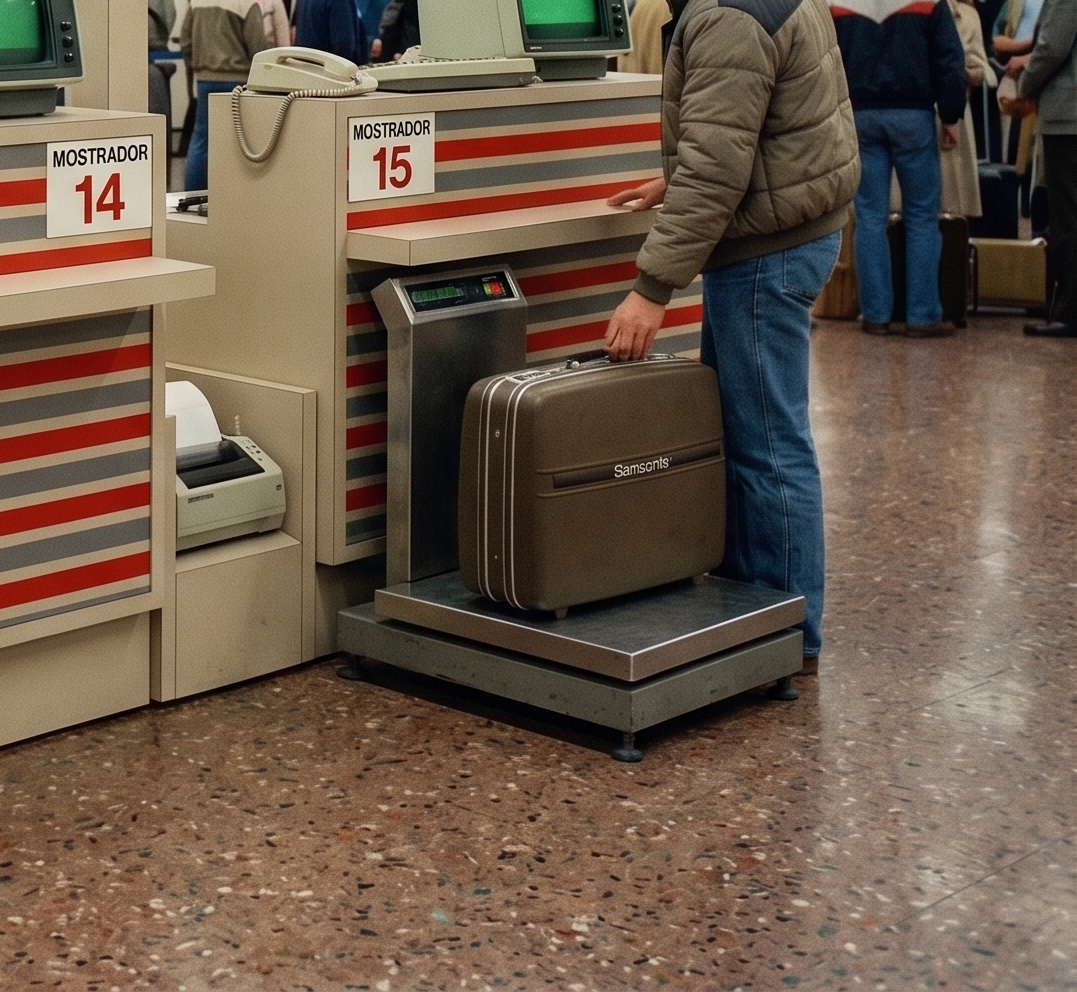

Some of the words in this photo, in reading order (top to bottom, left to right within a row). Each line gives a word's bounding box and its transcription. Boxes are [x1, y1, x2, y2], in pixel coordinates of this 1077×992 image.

[353, 119, 430, 141] MOSTRADOR
[53, 144, 148, 168] MOSTRADOR
[373, 145, 413, 190] 15
[75, 172, 125, 224] 14
